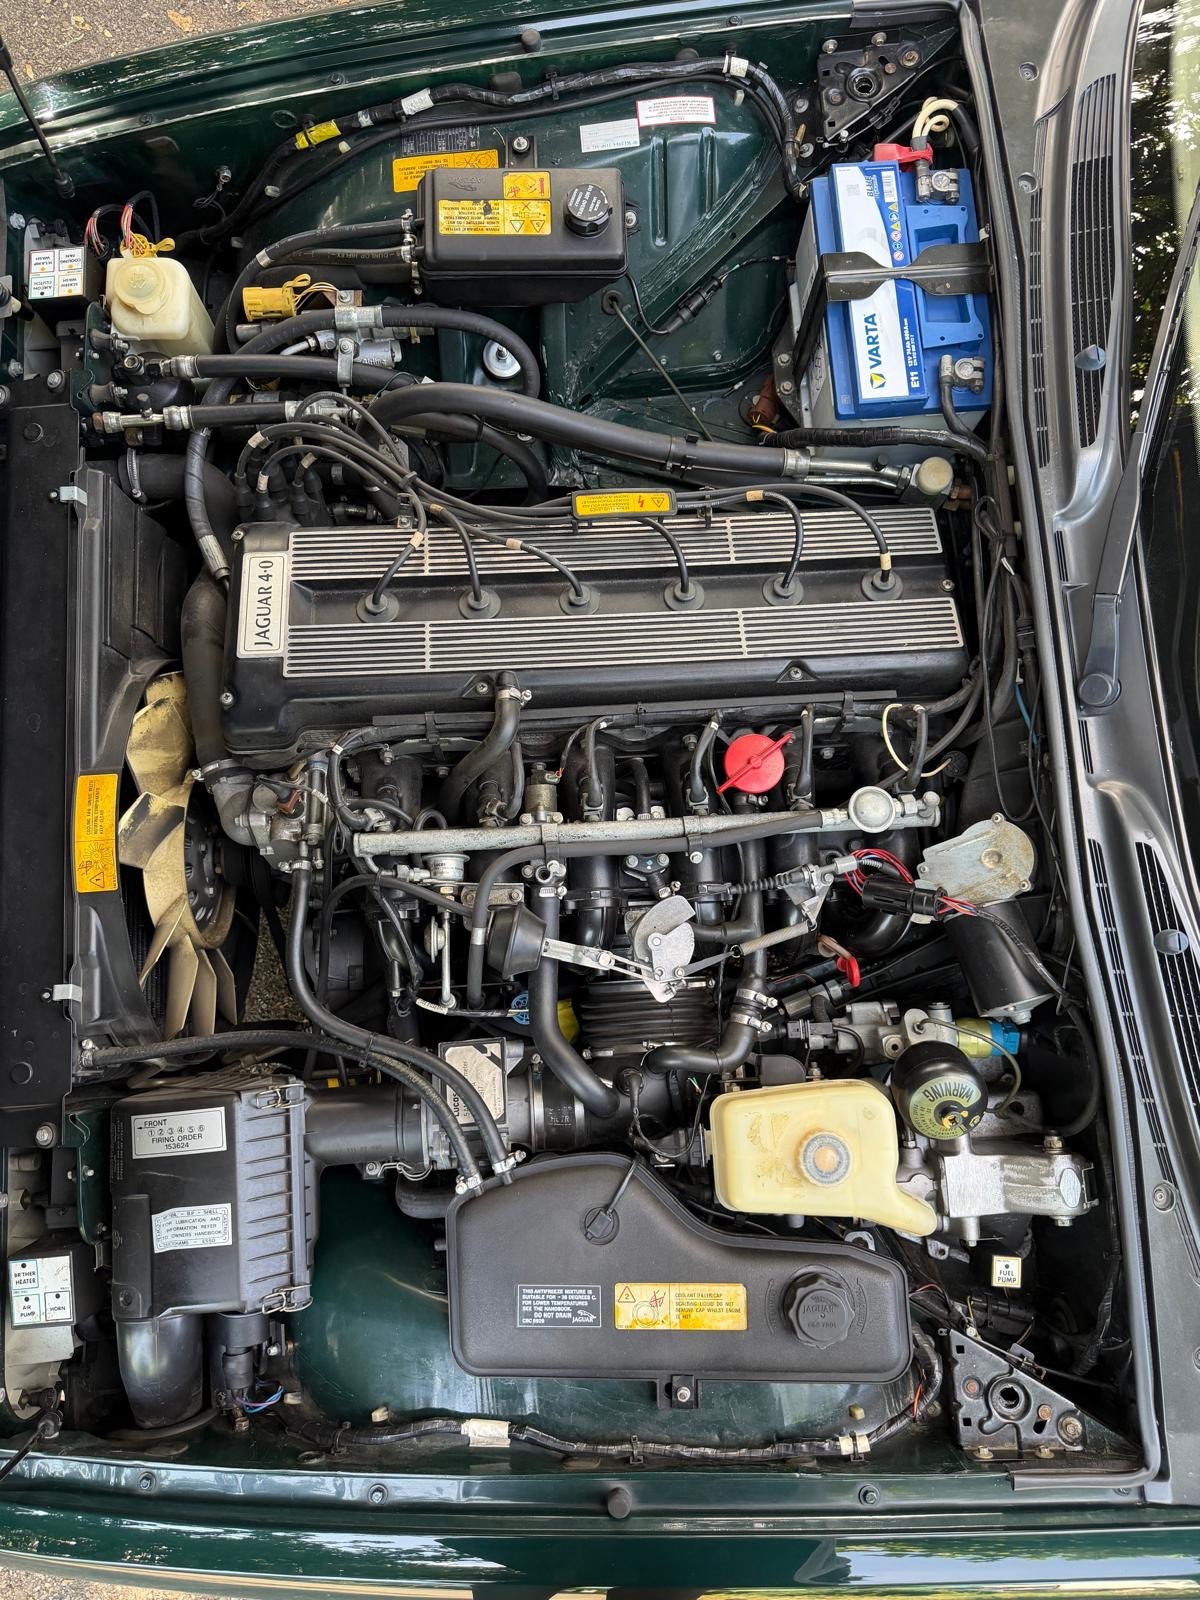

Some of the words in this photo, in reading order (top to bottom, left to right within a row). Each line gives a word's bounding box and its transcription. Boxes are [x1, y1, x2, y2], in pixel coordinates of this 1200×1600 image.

[864, 314, 881, 368] VARTA
[910, 371, 920, 388] E11
[254, 586, 272, 646] JAGUAR
[922, 1081, 974, 1102] WARNING
[144, 1119, 167, 1127] FRONT
[803, 1305, 834, 1313] JAGUAR
